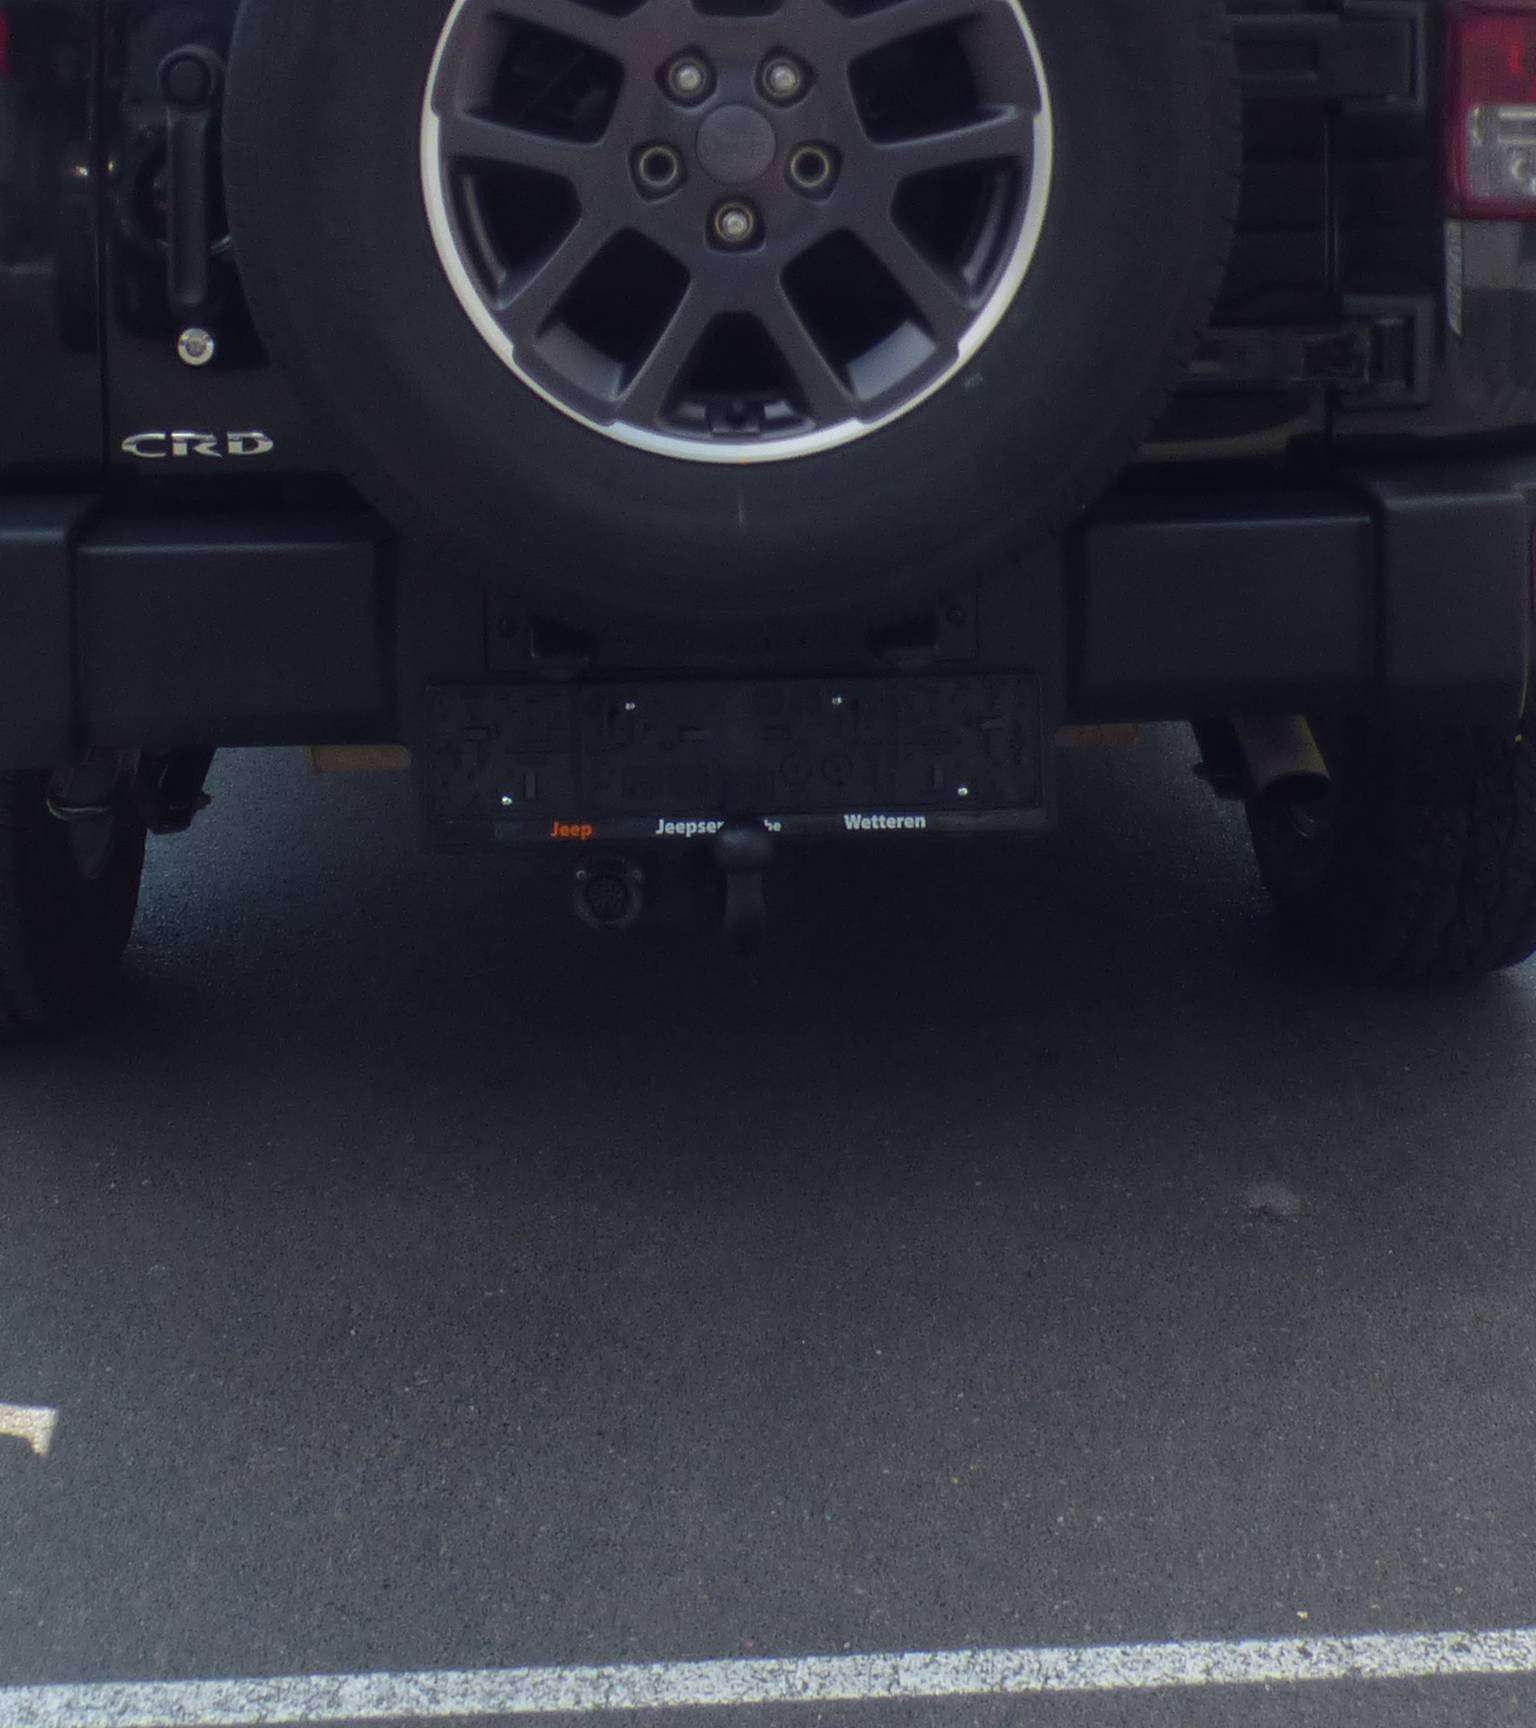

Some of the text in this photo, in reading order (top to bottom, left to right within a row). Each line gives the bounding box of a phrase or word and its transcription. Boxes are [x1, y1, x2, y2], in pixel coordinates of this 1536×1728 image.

[121, 429, 274, 459] CRD
[550, 820, 593, 841] Jeep
[843, 813, 926, 831] Wetteren
